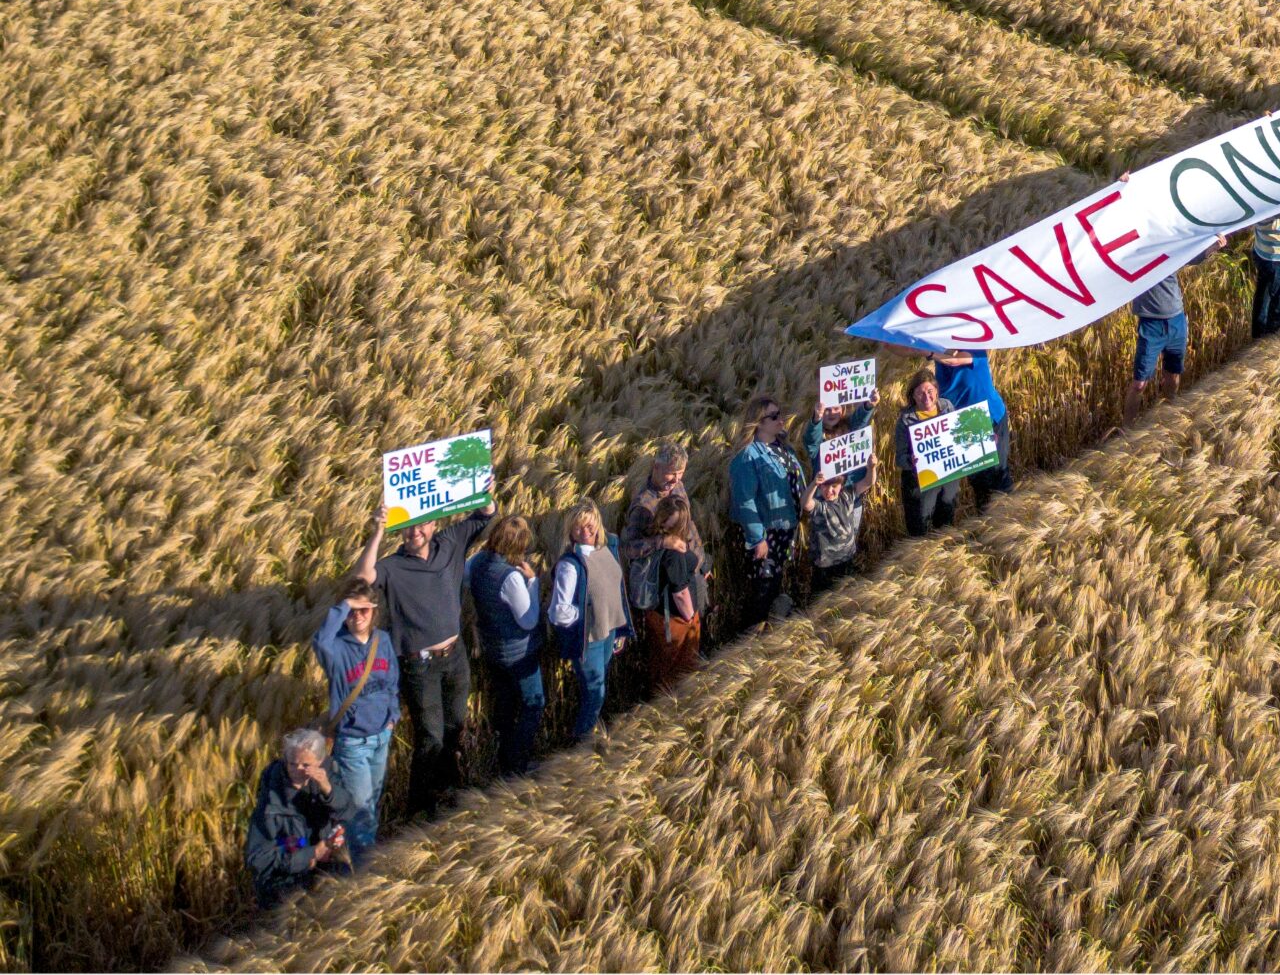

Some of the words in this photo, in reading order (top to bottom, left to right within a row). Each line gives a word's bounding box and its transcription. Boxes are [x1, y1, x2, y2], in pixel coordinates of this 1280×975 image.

[905, 190, 1170, 343] SAVE
[832, 364, 861, 378] SAVE
[823, 378, 848, 393] ONE
[914, 418, 950, 441] SAVE
[824, 448, 847, 465] ONE
[850, 438, 870, 453] TREE
[829, 433, 855, 451] SAVE
[917, 436, 942, 453] ONE
[388, 447, 436, 473] SAVE
[924, 445, 955, 464] TREE
[943, 454, 969, 472] HILL
[389, 468, 422, 487] ONE
[397, 479, 437, 500] TREE
[419, 490, 454, 510] HILL
